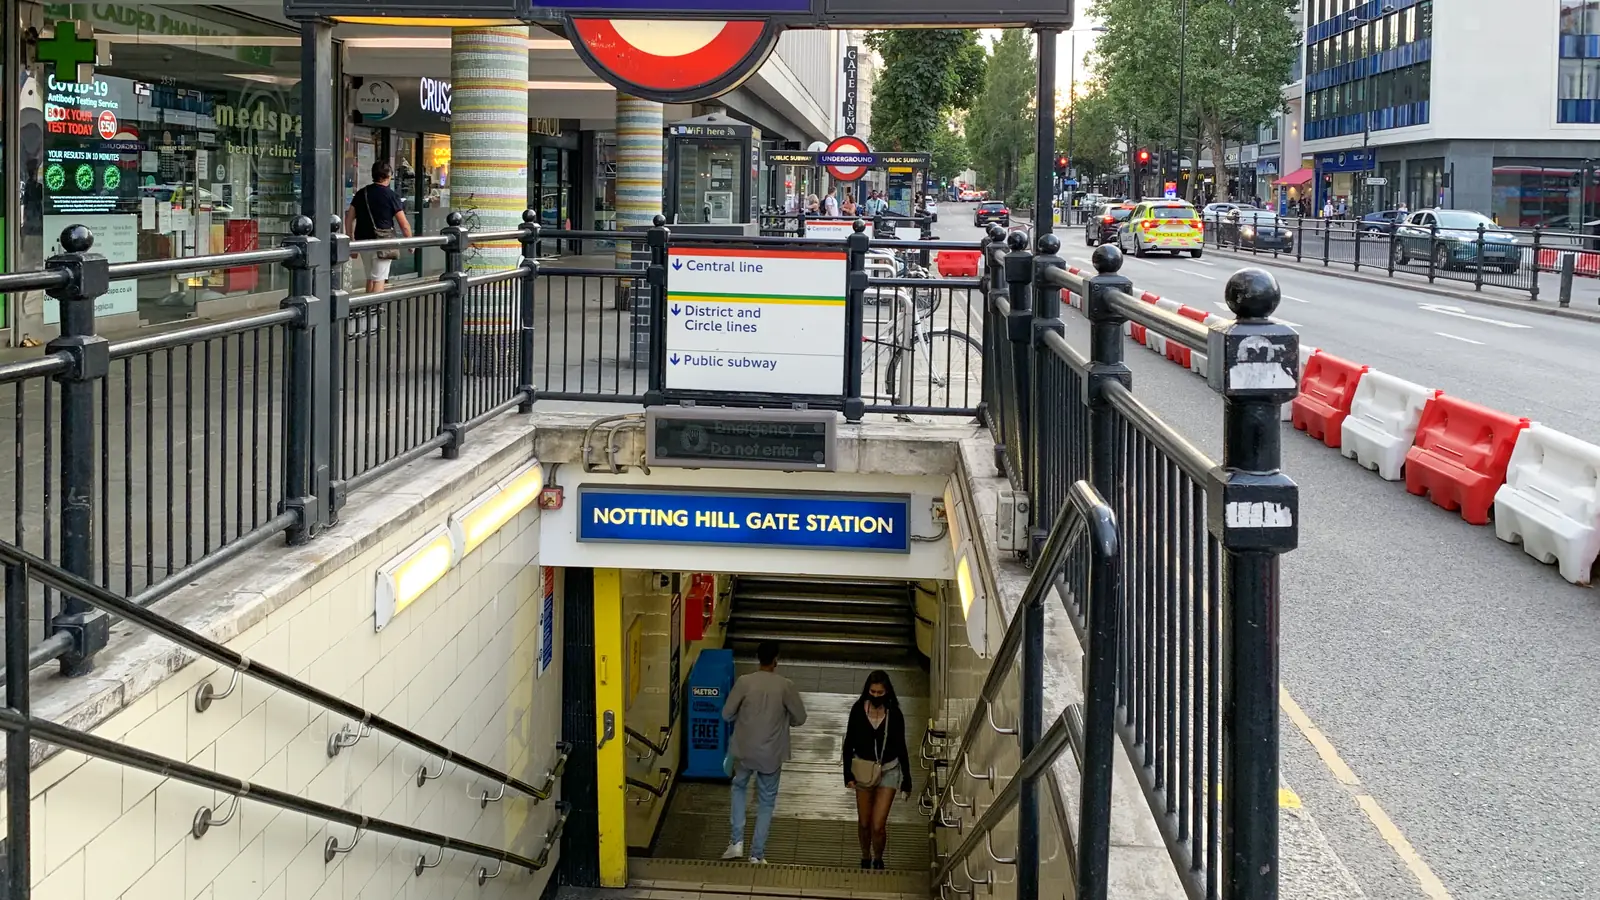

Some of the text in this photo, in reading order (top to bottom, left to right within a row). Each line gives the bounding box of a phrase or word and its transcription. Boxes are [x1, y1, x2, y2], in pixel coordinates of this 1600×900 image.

[92, 4, 156, 32] CALDER
[846, 50, 856, 130] GATE CINEMA
[48, 93, 119, 109] Antibody Testing Service
[47, 107, 93, 122] BOOK YOUR
[47, 121, 94, 136] TEST TODAY
[101, 120, 115, 133] £50
[535, 117, 563, 138] PAUL
[706, 127, 726, 136] here
[48, 150, 63, 158] YOUR
[63, 151, 85, 160] RESULTS
[227, 141, 297, 158] beauty clinic
[821, 155, 873, 163] UNDERGROUND
[686, 259, 764, 273] Central line
[685, 304, 761, 319] District and
[684, 319, 757, 333] Circle lines
[683, 354, 777, 371] Public subway
[714, 421, 798, 438] Emergency
[710, 442, 802, 458] Do not enter
[593, 507, 893, 534] NOTTING HILL GATE STATION
[693, 688, 719, 696] METRO
[692, 724, 719, 739] FREE
